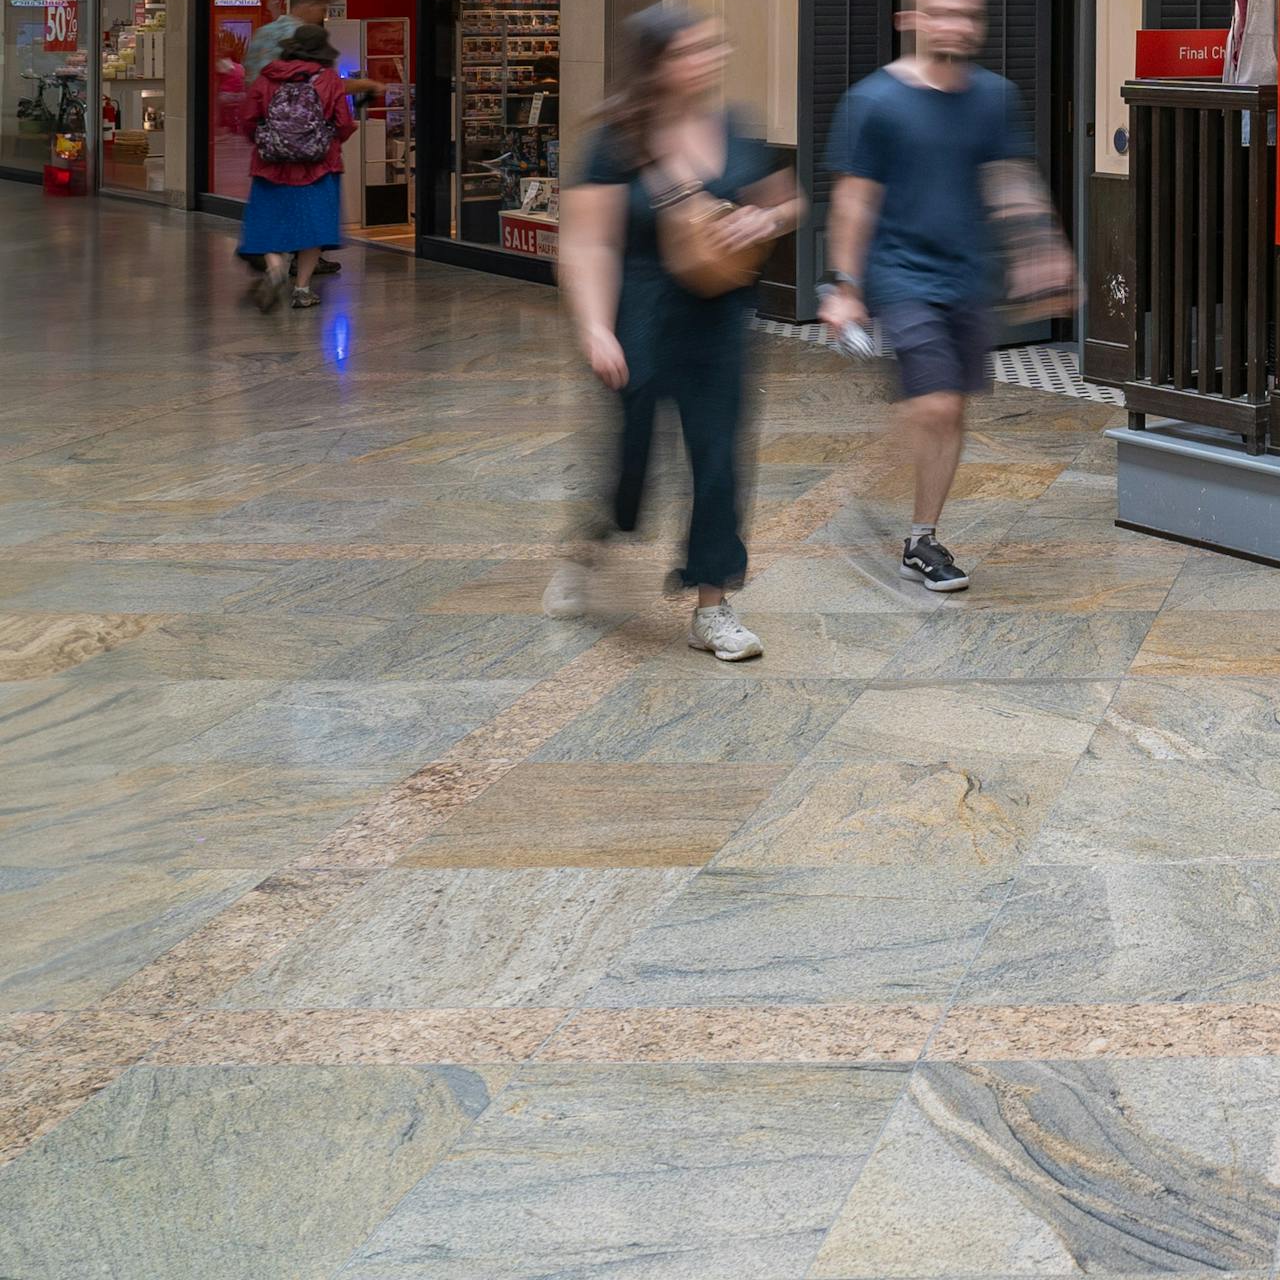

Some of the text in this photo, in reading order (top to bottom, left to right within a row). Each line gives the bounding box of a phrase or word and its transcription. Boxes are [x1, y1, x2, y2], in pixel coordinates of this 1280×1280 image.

[46, 6, 78, 41] 50%
[1179, 46, 1208, 59] Final
[504, 225, 535, 252] SALE
